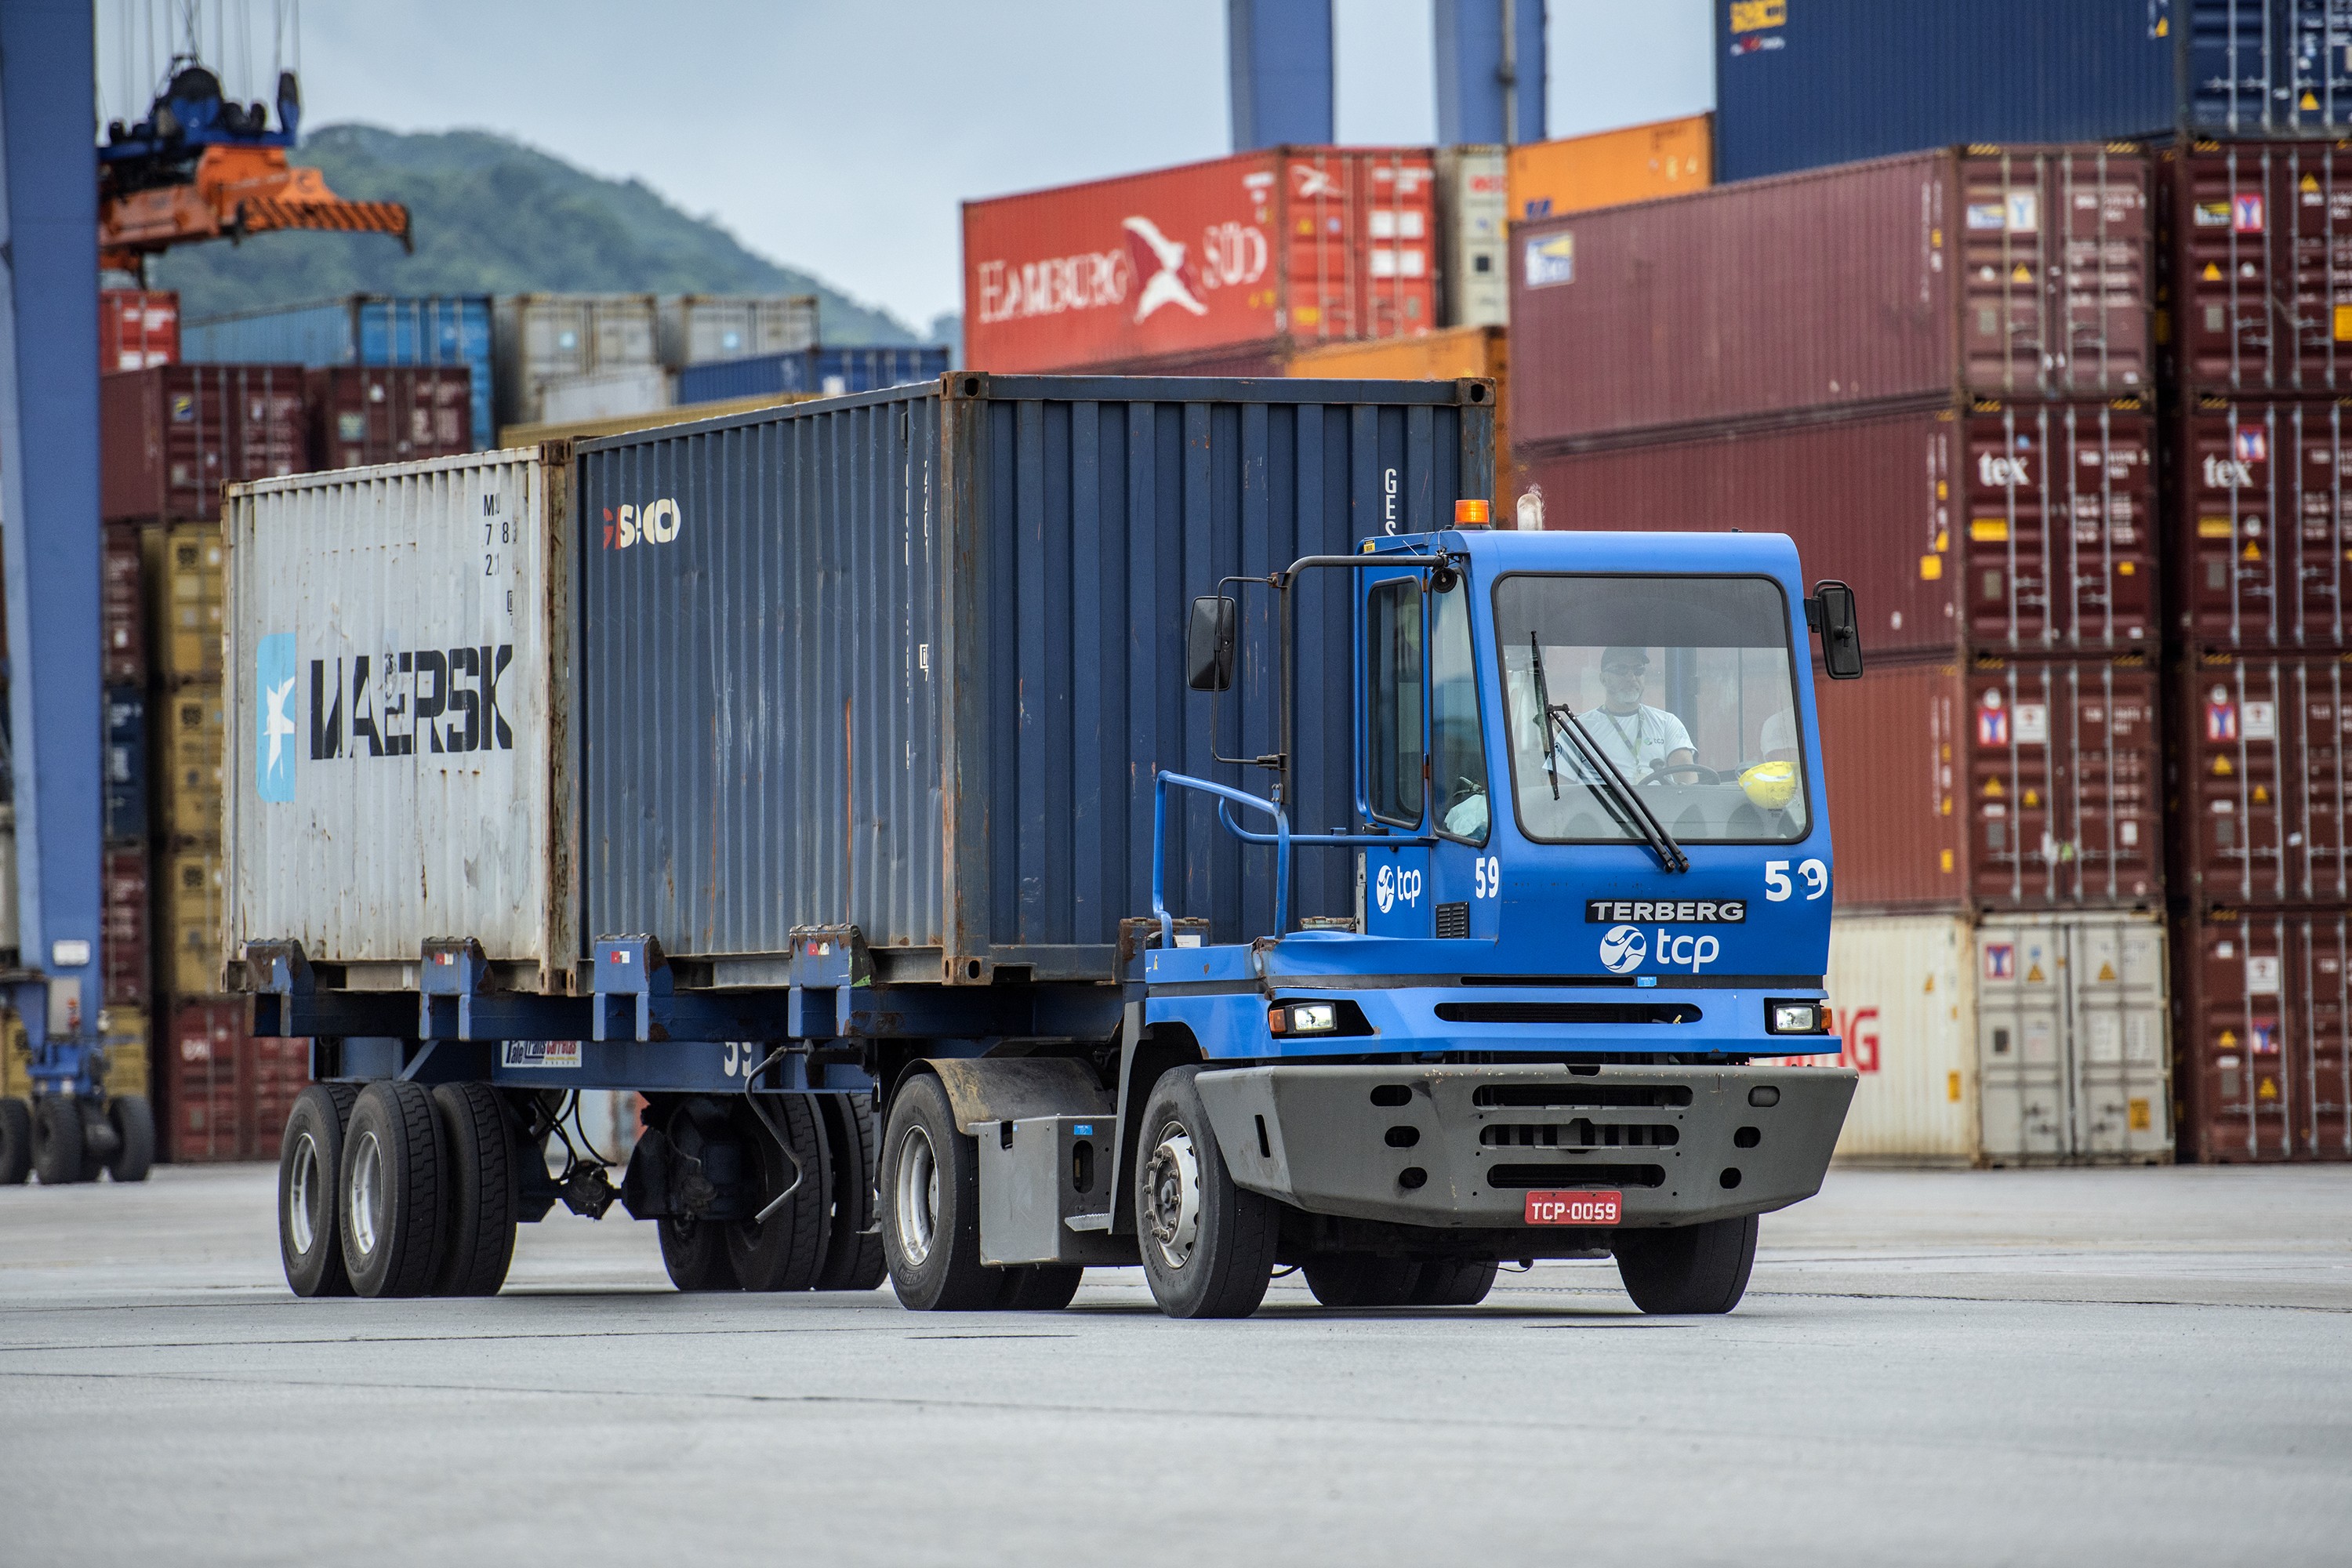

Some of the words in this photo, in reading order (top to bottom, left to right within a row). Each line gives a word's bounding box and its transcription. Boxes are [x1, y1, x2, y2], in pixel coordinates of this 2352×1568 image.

[1979, 451, 2030, 487] tex
[2203, 453, 2252, 488] tex
[310, 644, 513, 760] MAERSK
[1397, 866, 1421, 908] tcp
[1475, 856, 1499, 899] 59
[1766, 858, 1828, 902] 59
[1591, 902, 1744, 921] TERBERG
[1656, 928, 1719, 974] tcp
